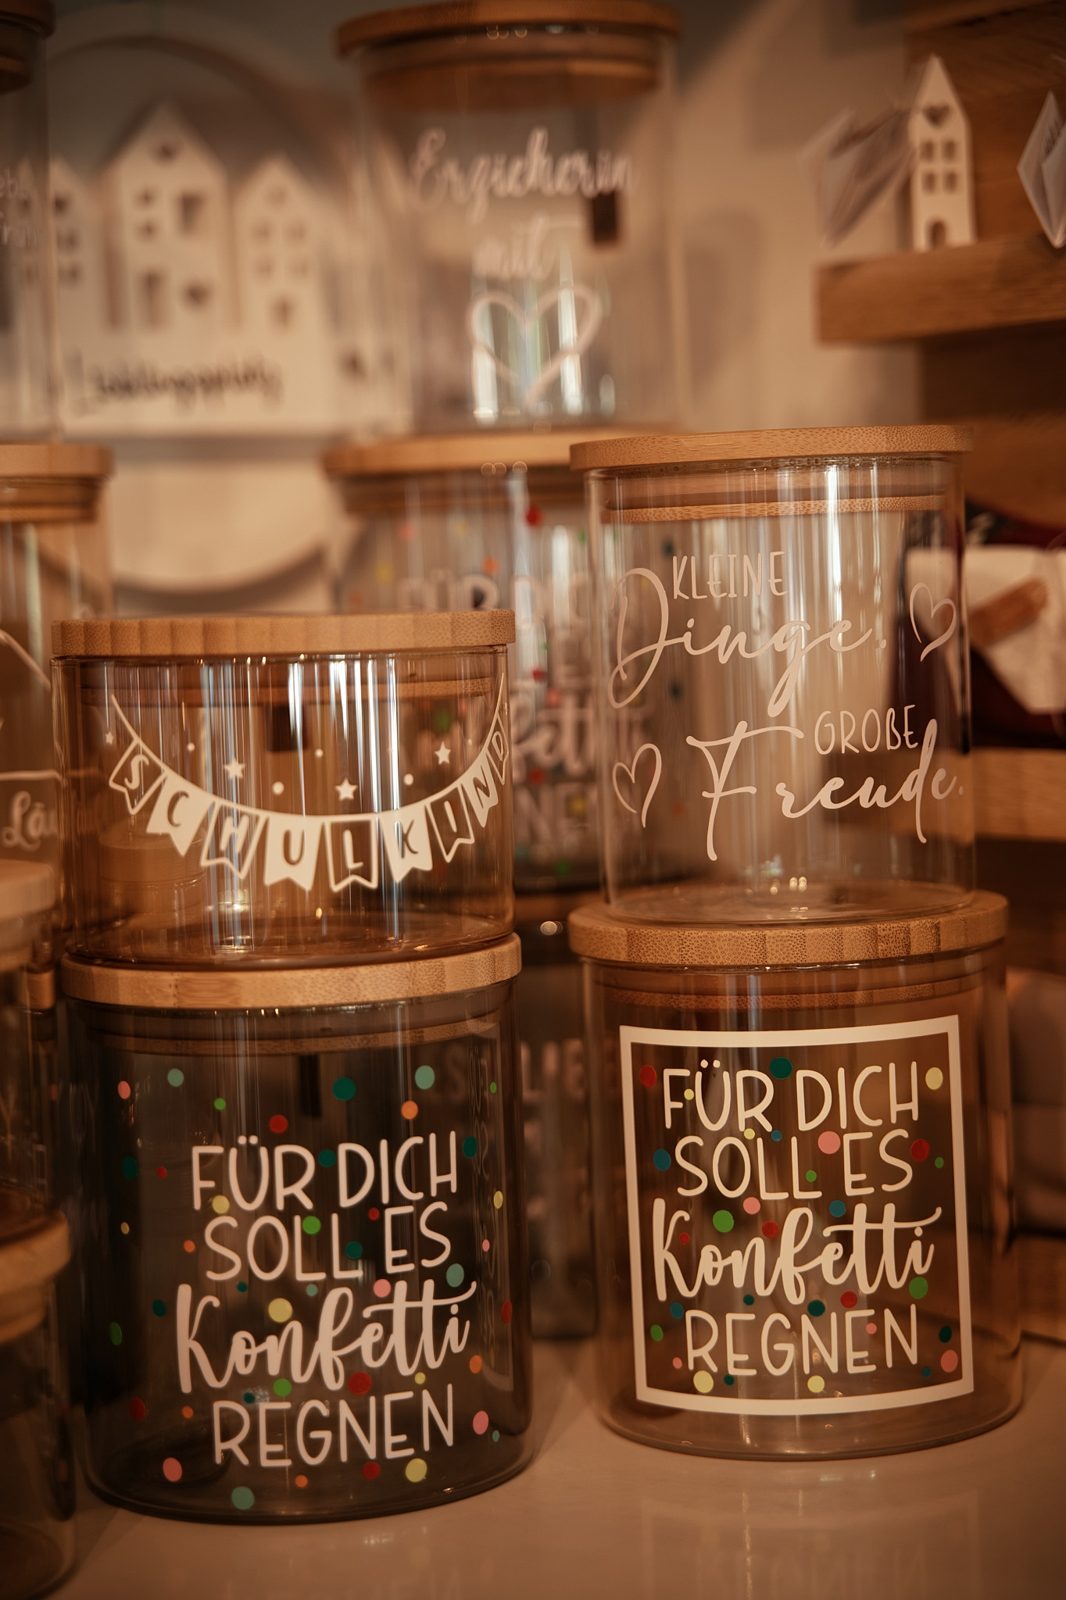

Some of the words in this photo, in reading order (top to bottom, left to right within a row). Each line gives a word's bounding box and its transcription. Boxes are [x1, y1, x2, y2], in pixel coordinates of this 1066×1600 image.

[671, 550, 787, 600] KLEINE
[124, 730, 506, 870] SCHULKIND
[663, 1059, 774, 1132] FÜR
[796, 1061, 919, 1131] DICH
[191, 1134, 315, 1212] FÜR
[338, 1130, 458, 1208] DICH
[675, 1135, 823, 1200] SOLL
[843, 1129, 913, 1196] ES
[204, 1212, 364, 1282] SOLL
[384, 1201, 451, 1274] ES
[652, 1198, 942, 1305] Konfetti
[176, 1278, 477, 1394] Konfetti
[685, 1303, 918, 1376] REGNEN
[212, 1383, 453, 1467] REGNEN
